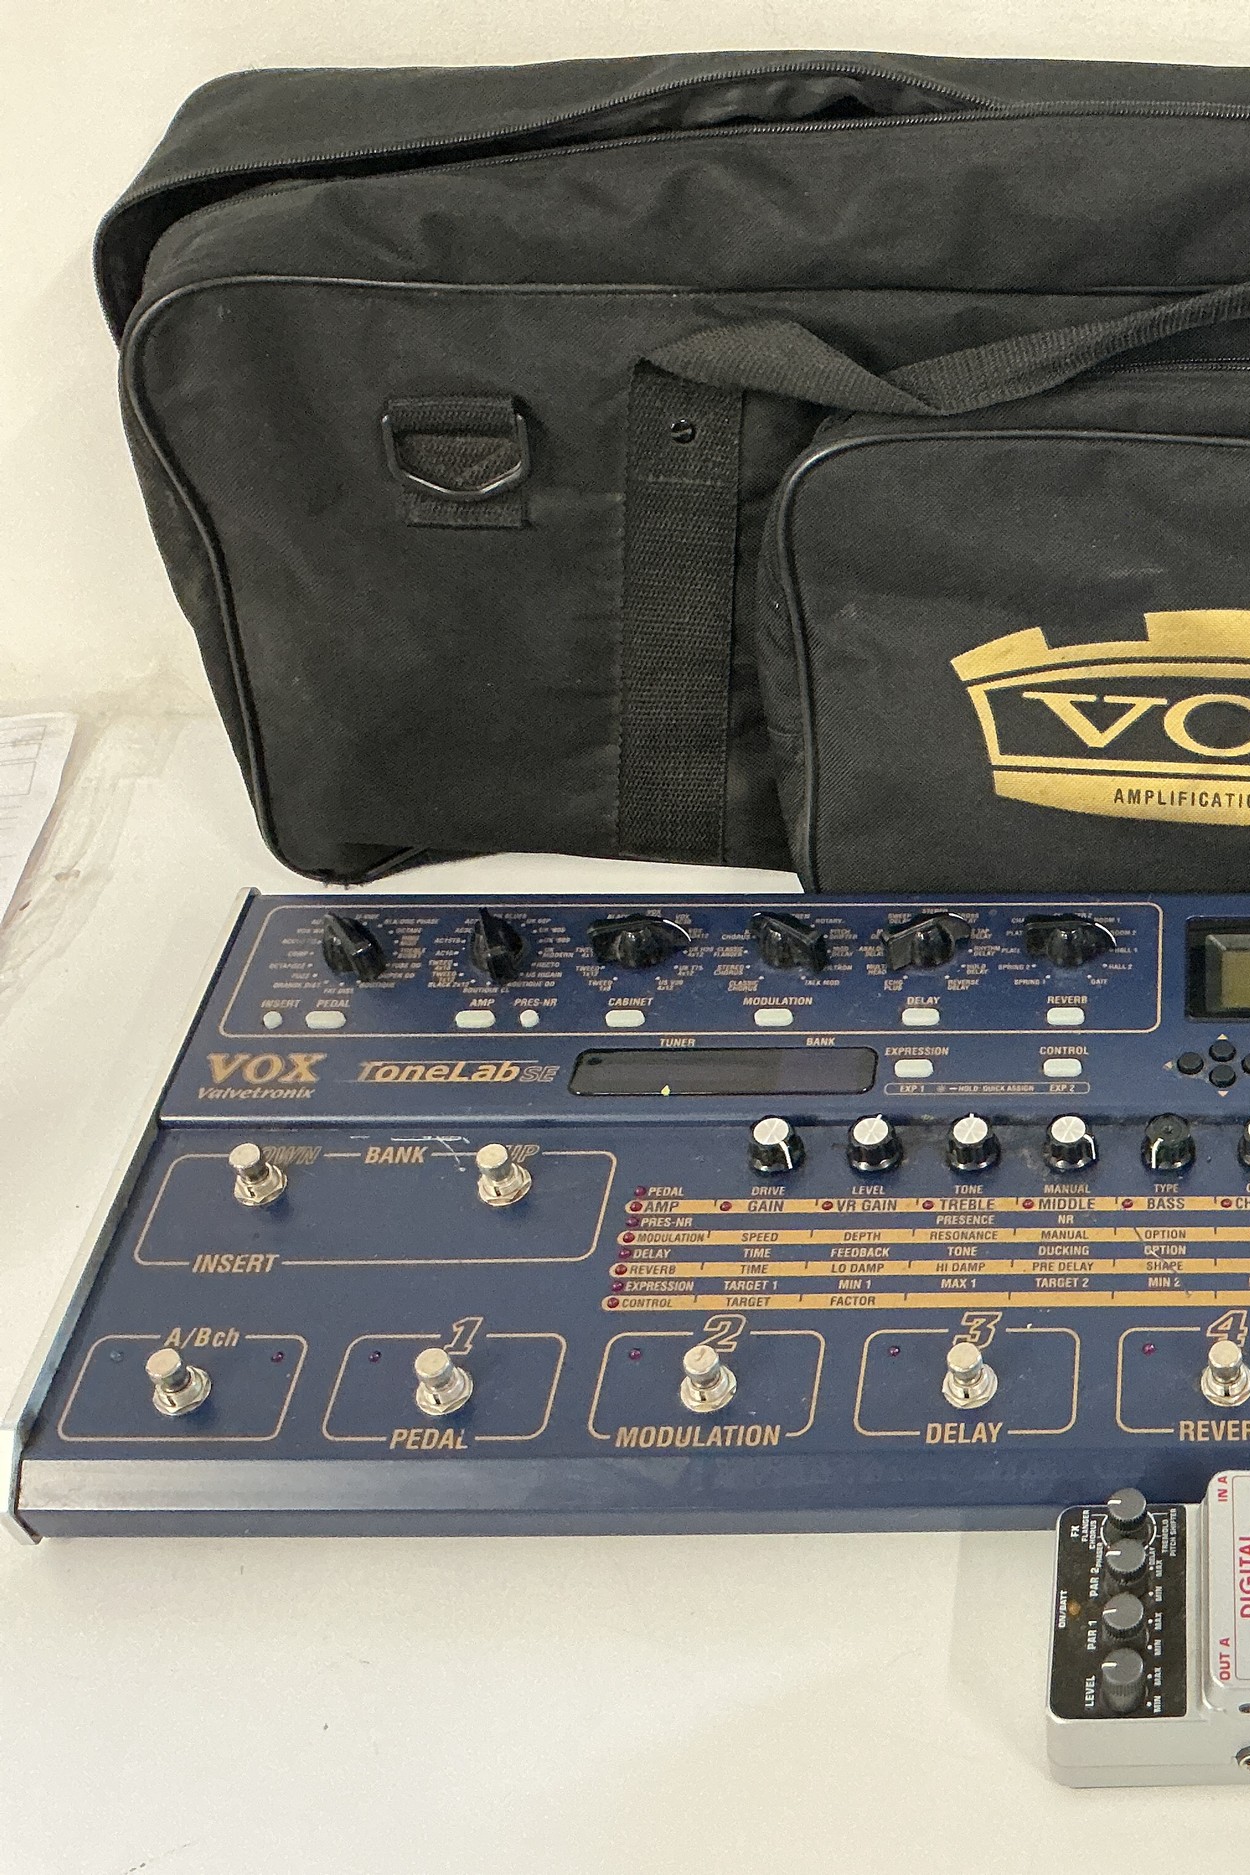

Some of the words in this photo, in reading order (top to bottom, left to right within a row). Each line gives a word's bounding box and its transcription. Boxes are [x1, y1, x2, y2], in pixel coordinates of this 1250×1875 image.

[261, 1000, 301, 1008] INSERT
[316, 999, 350, 1007] PEDAL
[469, 998, 495, 1007] AMP
[513, 998, 558, 1006] PRES-NR
[608, 997, 654, 1006] CABINET
[743, 997, 813, 1005] MODULATION
[907, 996, 941, 1005] DELAY
[1047, 996, 1088, 1004] REVERB
[659, 1038, 696, 1047] TUNER
[806, 1037, 836, 1046] BANK
[884, 1047, 949, 1056] EXPRESSION
[1039, 1046, 1089, 1055] CONTROL
[206, 1052, 327, 1085] VOX
[198, 1087, 315, 1100] Valvetronix
[900, 1084, 918, 1093] EXP
[1050, 1084, 1067, 1092] EXP
[263, 1145, 322, 1165] OWN
[364, 1146, 428, 1164] BANK
[648, 1186, 685, 1197] PEDAL
[751, 1186, 786, 1196] DRIVE
[851, 1185, 886, 1196] LEVEL
[954, 1184, 983, 1195] TONE
[1043, 1183, 1091, 1194] MANUAL
[1153, 1183, 1179, 1193] TYPE
[643, 1201, 679, 1213] AMP
[747, 1200, 784, 1212] GAIN
[837, 1200, 857, 1212] VR
[860, 1200, 898, 1211] GAIN
[939, 1199, 995, 1211] TREBLE
[1038, 1198, 1097, 1210] MIDDLE
[1146, 1198, 1186, 1210] BASS
[640, 1216, 693, 1228] PRES-NR
[936, 1215, 996, 1226] PRESENCE
[1058, 1214, 1075, 1225] NR
[637, 1232, 705, 1243] MODULATION
[741, 1232, 779, 1242] SPEED
[843, 1231, 881, 1242] DEPTH
[929, 1230, 999, 1241] RESONANCE
[1040, 1229, 1090, 1240] MANUAL
[1144, 1229, 1187, 1240] OPTION
[632, 1248, 672, 1259] DELAY
[743, 1248, 772, 1258] TIME
[830, 1247, 891, 1258] FEEDBACK
[947, 1246, 978, 1257] TONE
[1038, 1245, 1090, 1256] DUCKING
[1143, 1245, 1187, 1256] OPTION
[192, 1254, 280, 1274] INSERT
[629, 1264, 677, 1275] REVERB
[740, 1264, 769, 1274] TIME
[831, 1263, 847, 1274] LO
[850, 1263, 885, 1274] DAMP
[936, 1262, 950, 1272] HI
[952, 1262, 986, 1272] DAMP
[1032, 1261, 1055, 1272] PRE
[1058, 1261, 1094, 1272] DELAY
[1146, 1260, 1184, 1271] SHAPE
[625, 1280, 694, 1292] EXPRESSION
[724, 1280, 769, 1291] TARGET
[838, 1279, 863, 1290] MIN
[941, 1278, 967, 1289] MAX
[1035, 1277, 1079, 1288] TARGET
[1081, 1277, 1089, 1288] 2
[1148, 1277, 1171, 1288] MIN
[622, 1298, 673, 1308] CONTROL
[726, 1297, 772, 1308] TARGET
[830, 1295, 876, 1306] FACTOR
[697, 1313, 748, 1353] 2
[951, 1311, 1004, 1351] 3
[1205, 1309, 1249, 1348] 4
[443, 1317, 485, 1356] 1
[615, 1424, 782, 1448] MODULATION
[925, 1421, 1004, 1444] DELAY
[390, 1428, 469, 1451] PEDAL
[1218, 1476, 1228, 1484] A
[1218, 1489, 1228, 1502] IN
[1071, 1525, 1079, 1538] FX
[1081, 1510, 1090, 1542] FLANGER
[1169, 1534, 1177, 1557] PITCH
[1155, 1560, 1163, 1578] MAX
[1089, 1576, 1099, 1597] PAR
[1155, 1586, 1163, 1602] MIN
[1059, 1590, 1068, 1628] ON/BATT
[1154, 1613, 1163, 1631] MAX
[1087, 1629, 1097, 1650] PAR
[1219, 1637, 1230, 1647] A
[1154, 1639, 1162, 1656] MIN
[1219, 1653, 1231, 1680] OUT
[1154, 1667, 1162, 1687] MAX
[1085, 1675, 1095, 1708] LEVEL
[1154, 1696, 1162, 1714] MIN
